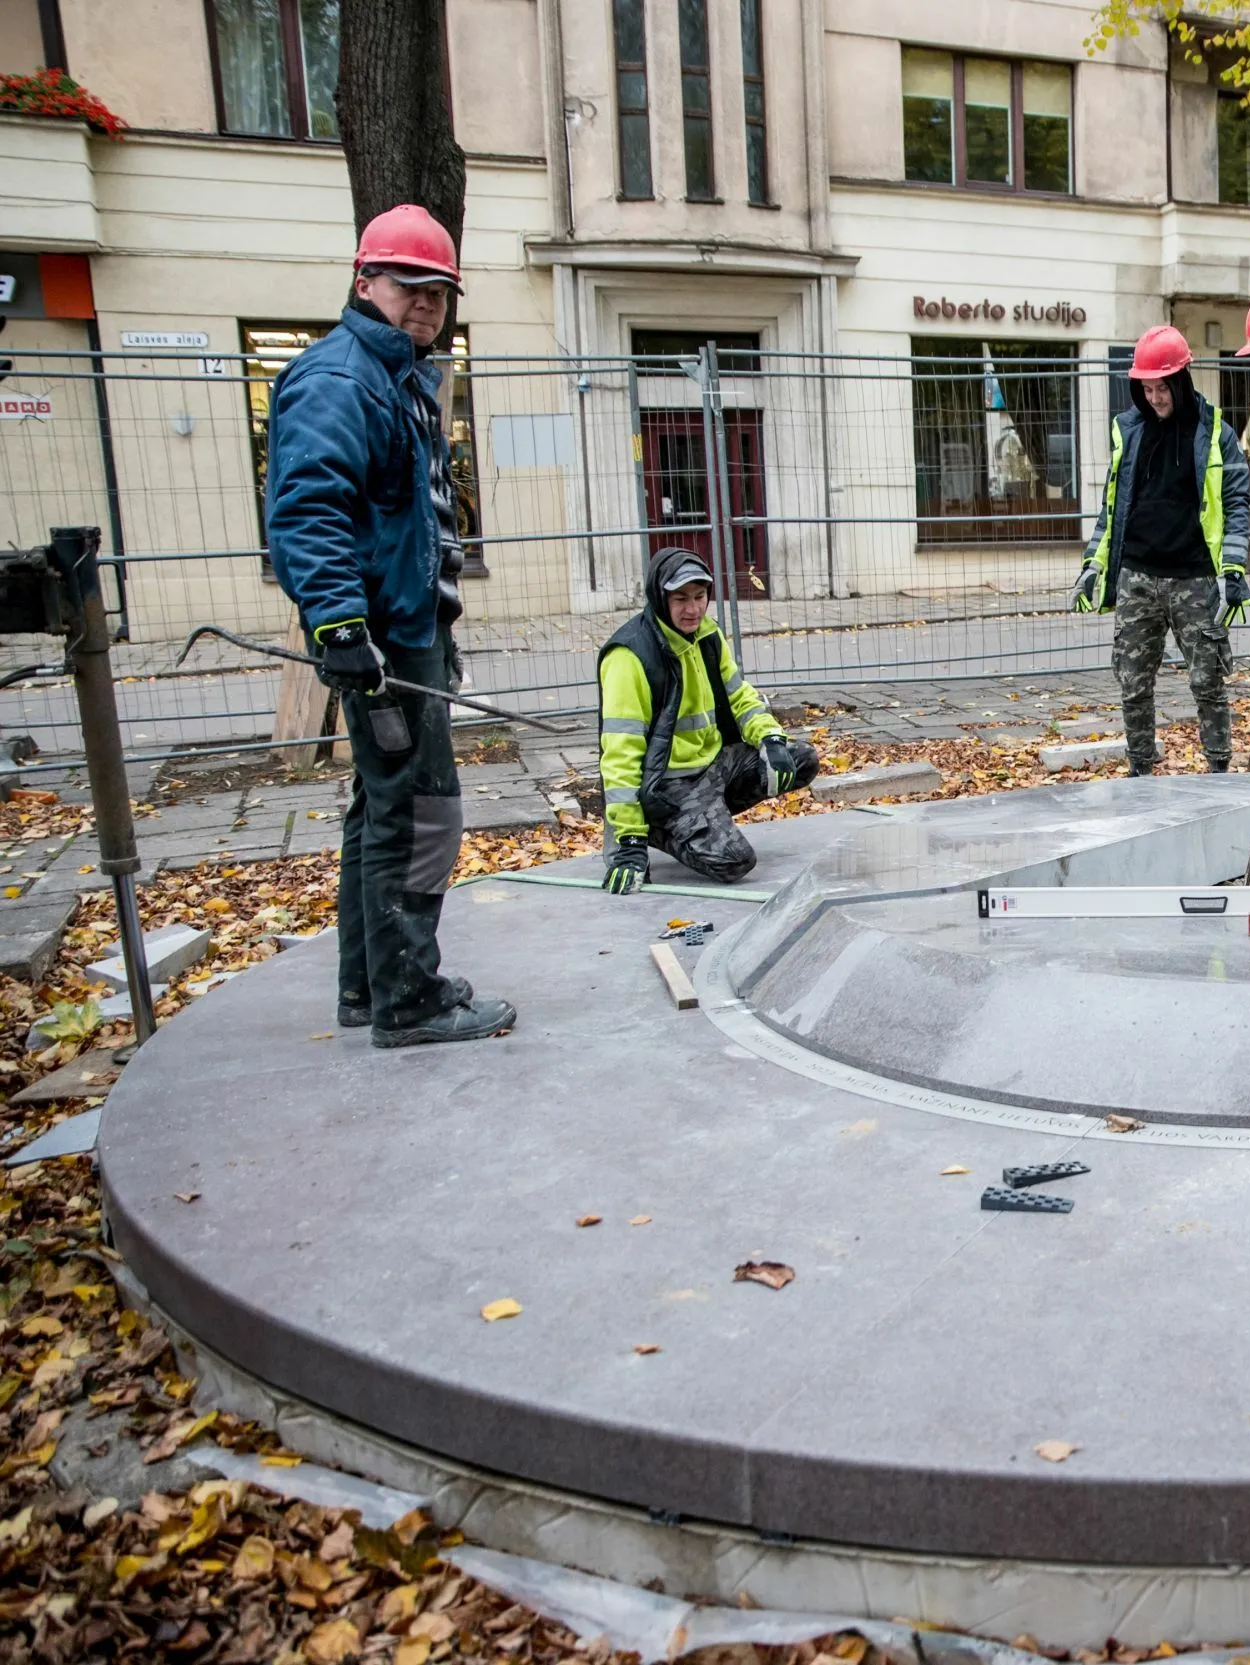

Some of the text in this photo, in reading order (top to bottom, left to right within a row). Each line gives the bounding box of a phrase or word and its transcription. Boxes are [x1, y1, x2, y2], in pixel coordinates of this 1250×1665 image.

[912, 296, 1087, 328] Roberto studija
[201, 356, 223, 374] 12
